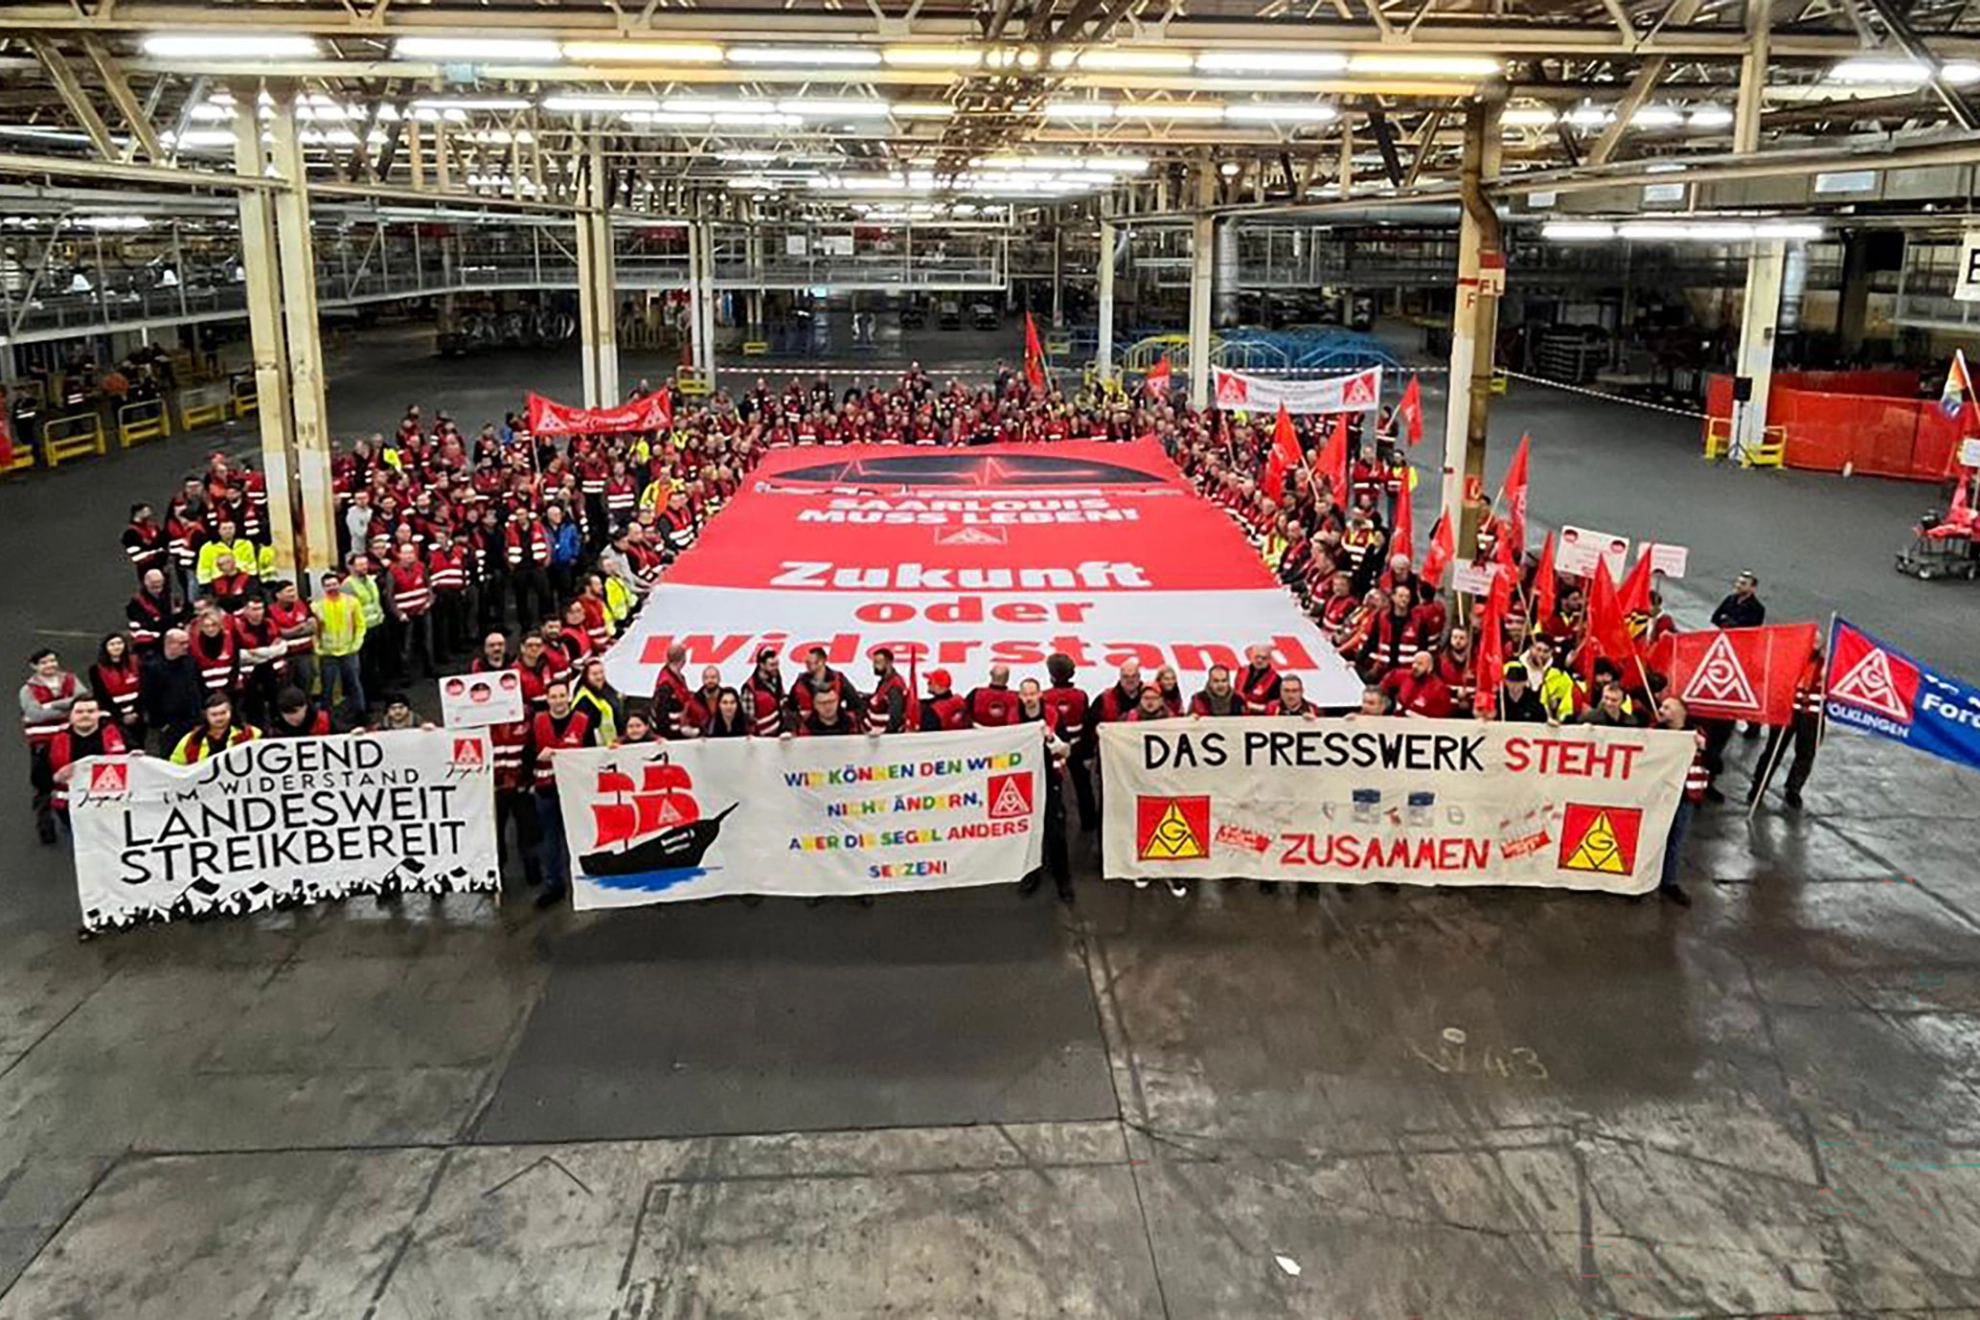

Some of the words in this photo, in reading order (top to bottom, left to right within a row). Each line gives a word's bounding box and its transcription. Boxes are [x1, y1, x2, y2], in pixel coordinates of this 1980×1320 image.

[797, 509, 948, 524] MUSS
[962, 508, 1140, 524] LEBEN!
[827, 498, 1112, 511] SAARLOUIS
[769, 560, 1151, 588] Zukunft
[855, 596, 1093, 623] oder
[639, 633, 1318, 670] Widerstand
[199, 739, 384, 785] JUGEND
[920, 759, 962, 776] DEN
[1144, 733, 1227, 769] DAS
[1245, 732, 1484, 771] PRESSWERK
[1505, 738, 1643, 780] STEHT
[218, 767, 420, 797] WIDERSTAND
[124, 785, 457, 848] LANDESWEIT
[948, 818, 1029, 841] ANDERS
[121, 821, 466, 885] STREIKBEREIT
[1280, 834, 1490, 870] ZUSAMMEN
[868, 860, 948, 878] SEZEN!
